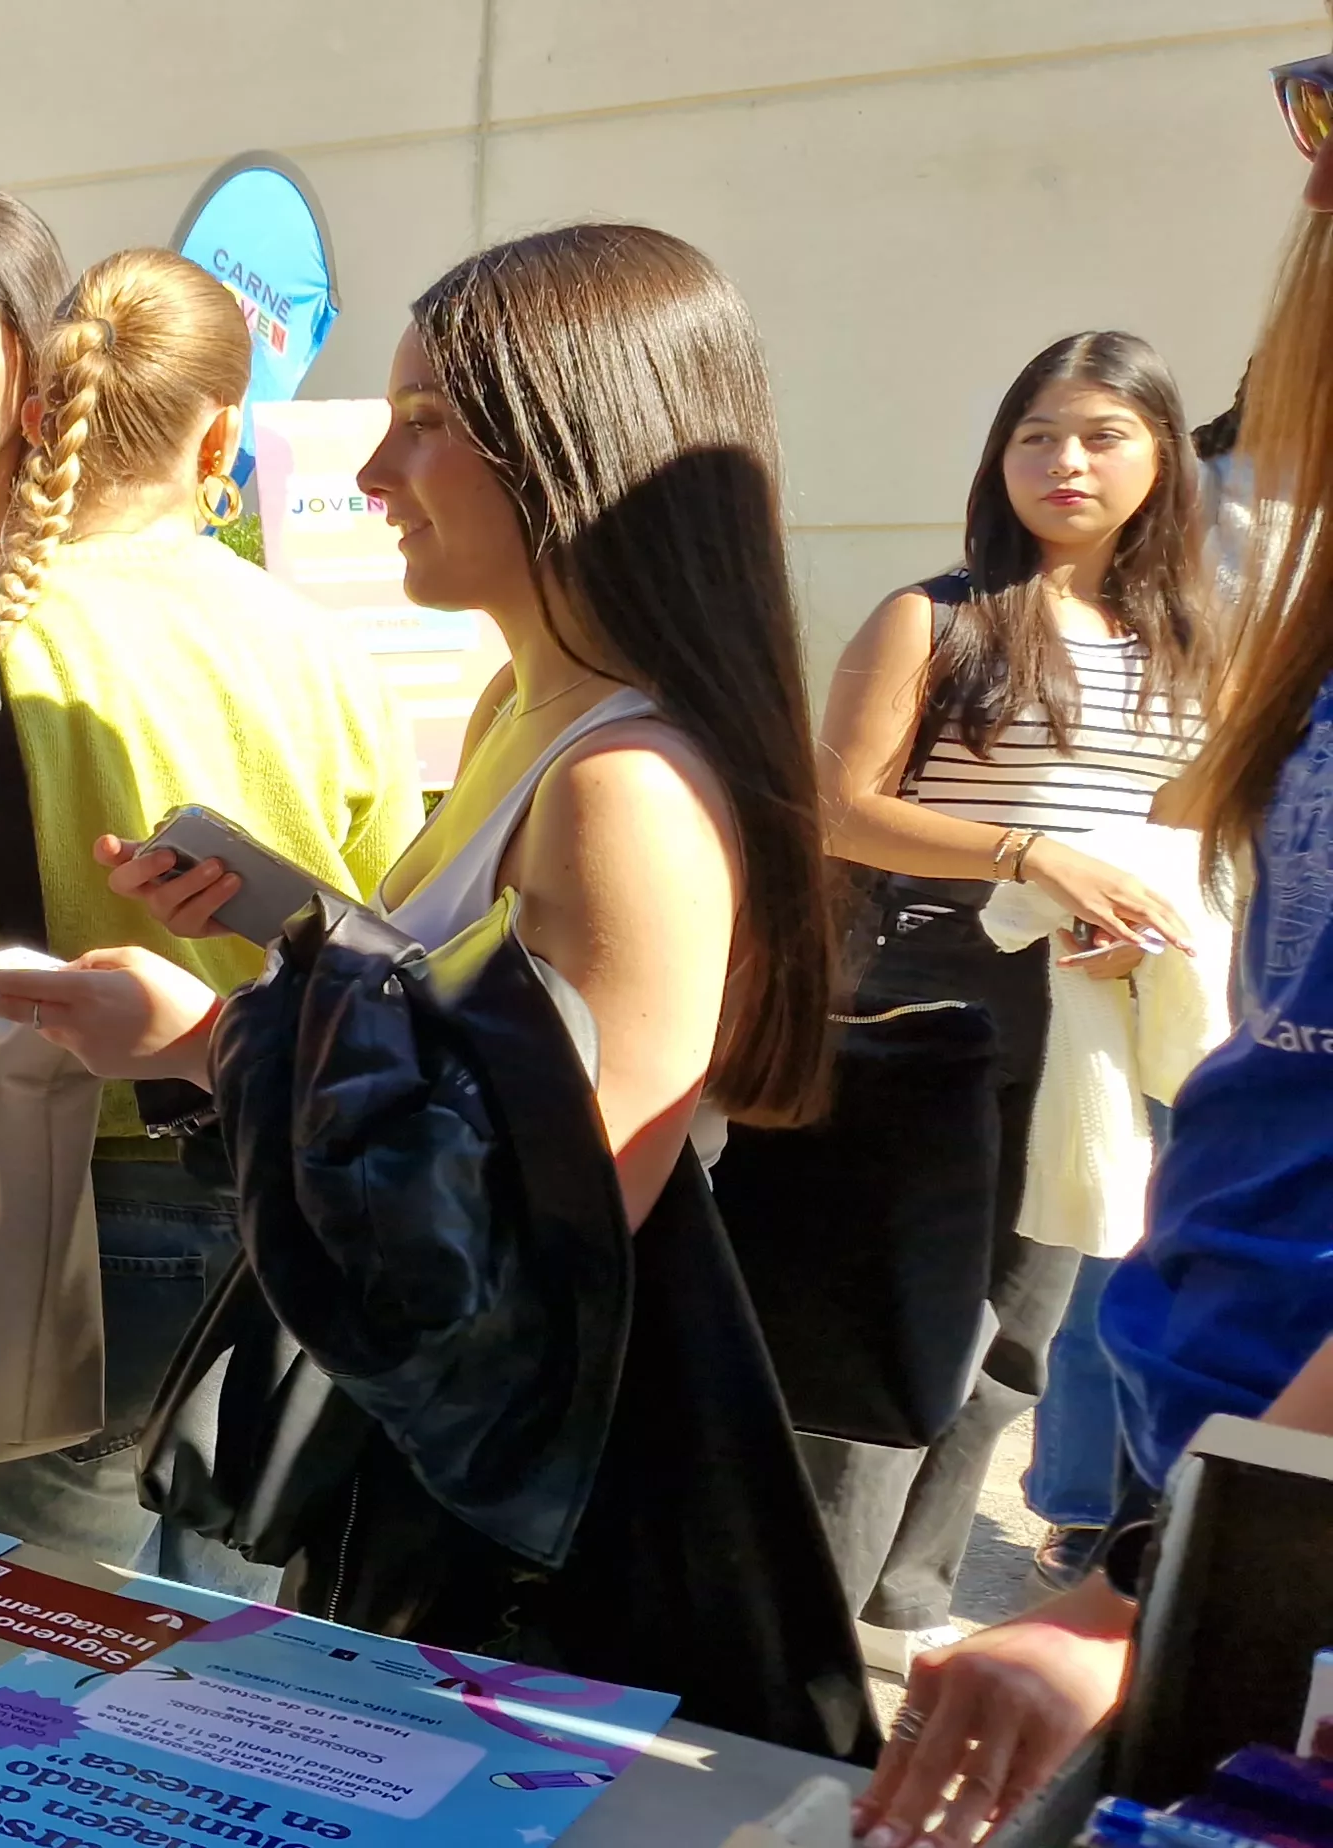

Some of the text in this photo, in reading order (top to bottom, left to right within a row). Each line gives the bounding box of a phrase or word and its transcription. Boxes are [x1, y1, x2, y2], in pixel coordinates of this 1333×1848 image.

[213, 249, 291, 325] CARNÉ
[240, 297, 285, 354] VEN
[291, 497, 384, 514] JOVEN
[1255, 1008, 1333, 1053] Zara
[195, 1680, 272, 1704] octubre
[93, 1712, 141, 1727] años
[101, 1704, 150, 1720] años
[223, 1706, 271, 1721] años
[350, 1718, 410, 1738] Hasta
[218, 1748, 290, 1770] infantil
[233, 1740, 303, 1763] juvenil
[285, 1733, 386, 1762] Concurso
[257, 1768, 357, 1797] Concurso
[292, 1769, 402, 1800] Modalidad
[303, 1761, 414, 1793] Modalidad
[6, 1761, 299, 1848] luntariado
[46, 1799, 193, 1848] agen
[281, 1809, 352, 1842] en
